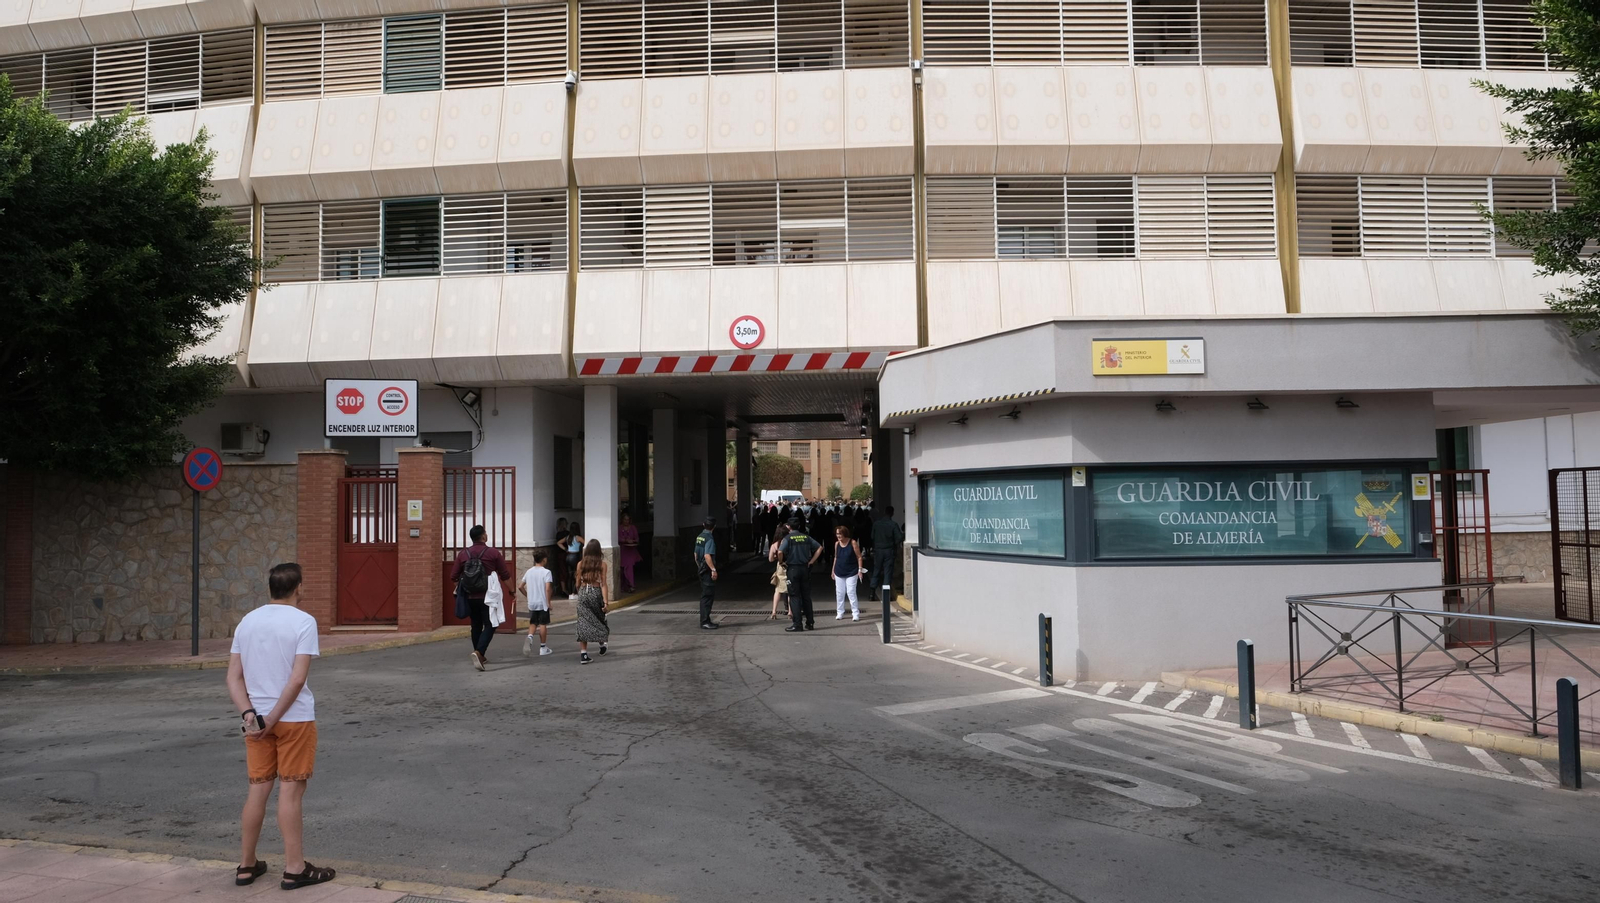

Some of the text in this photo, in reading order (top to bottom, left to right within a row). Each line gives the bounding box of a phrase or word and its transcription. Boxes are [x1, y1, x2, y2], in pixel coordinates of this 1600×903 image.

[736, 326, 758, 337] 3,50m
[337, 396, 363, 406] STOP
[328, 424, 415, 432] ENCENDER LUZ INTERIOR
[954, 484, 1038, 502] GUARDIA CIVIL
[1117, 480, 1320, 504] GUARDIA CIVIL
[962, 517, 1030, 530] COMANDANCIA
[1158, 511, 1278, 526] COMANDANCIA
[970, 531, 1022, 544] DE ALMERÍA
[1172, 528, 1264, 544] DE ALMERÍA
